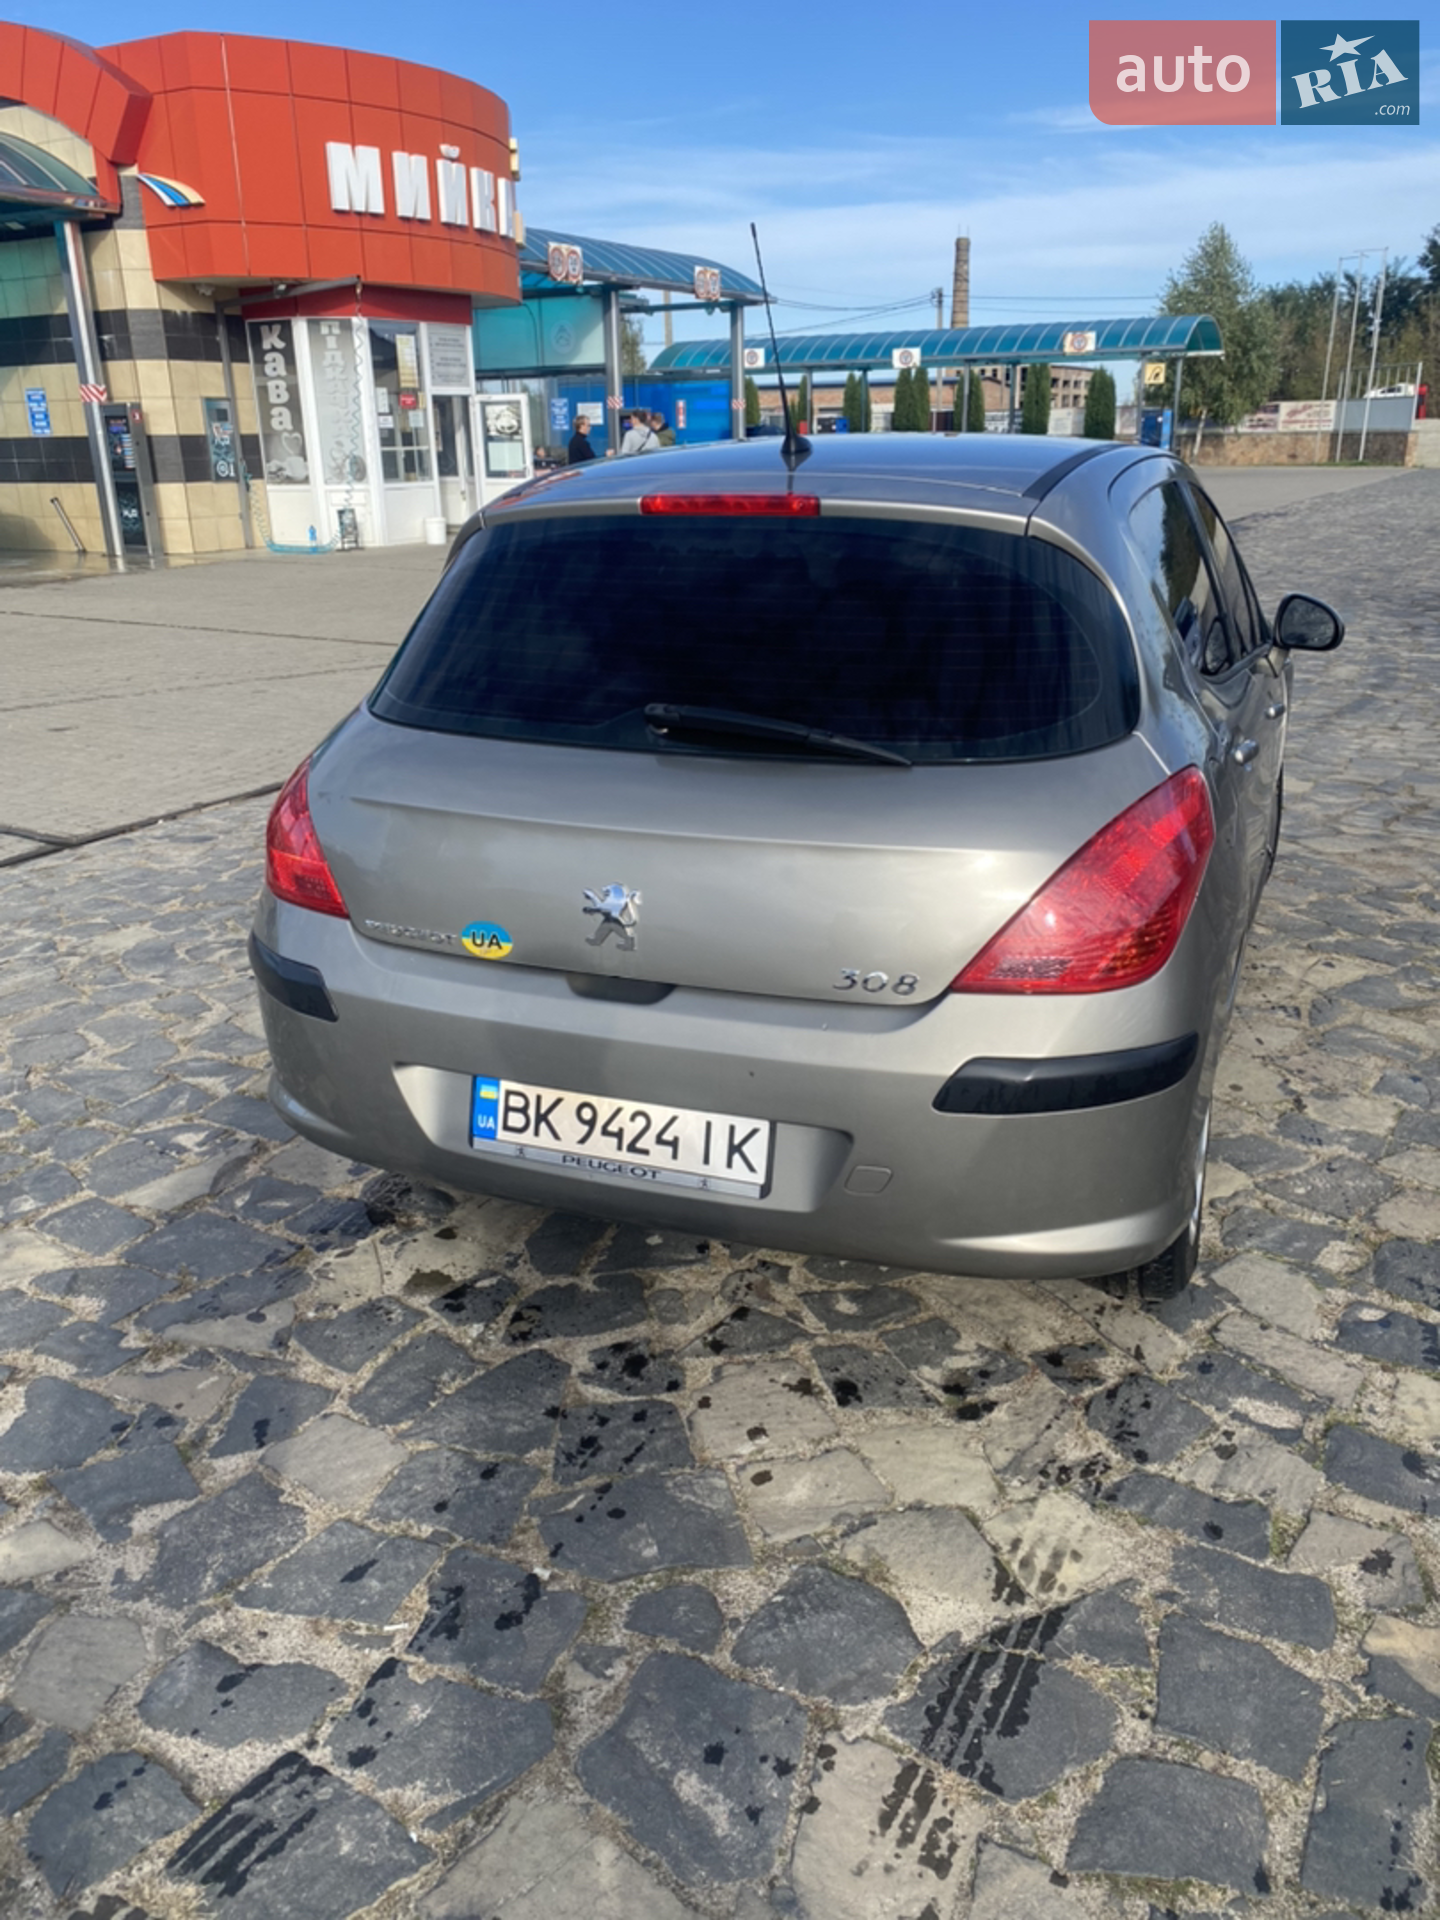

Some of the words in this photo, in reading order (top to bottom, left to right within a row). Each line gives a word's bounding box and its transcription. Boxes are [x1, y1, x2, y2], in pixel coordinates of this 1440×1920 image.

[471, 931, 503, 949] UA
[833, 968, 920, 996] 308
[477, 1114, 495, 1130] UA
[502, 1089, 564, 1141] BK
[575, 1101, 680, 1160] 9424
[703, 1120, 761, 1174] IK
[562, 1154, 661, 1180] PEUGEOT
